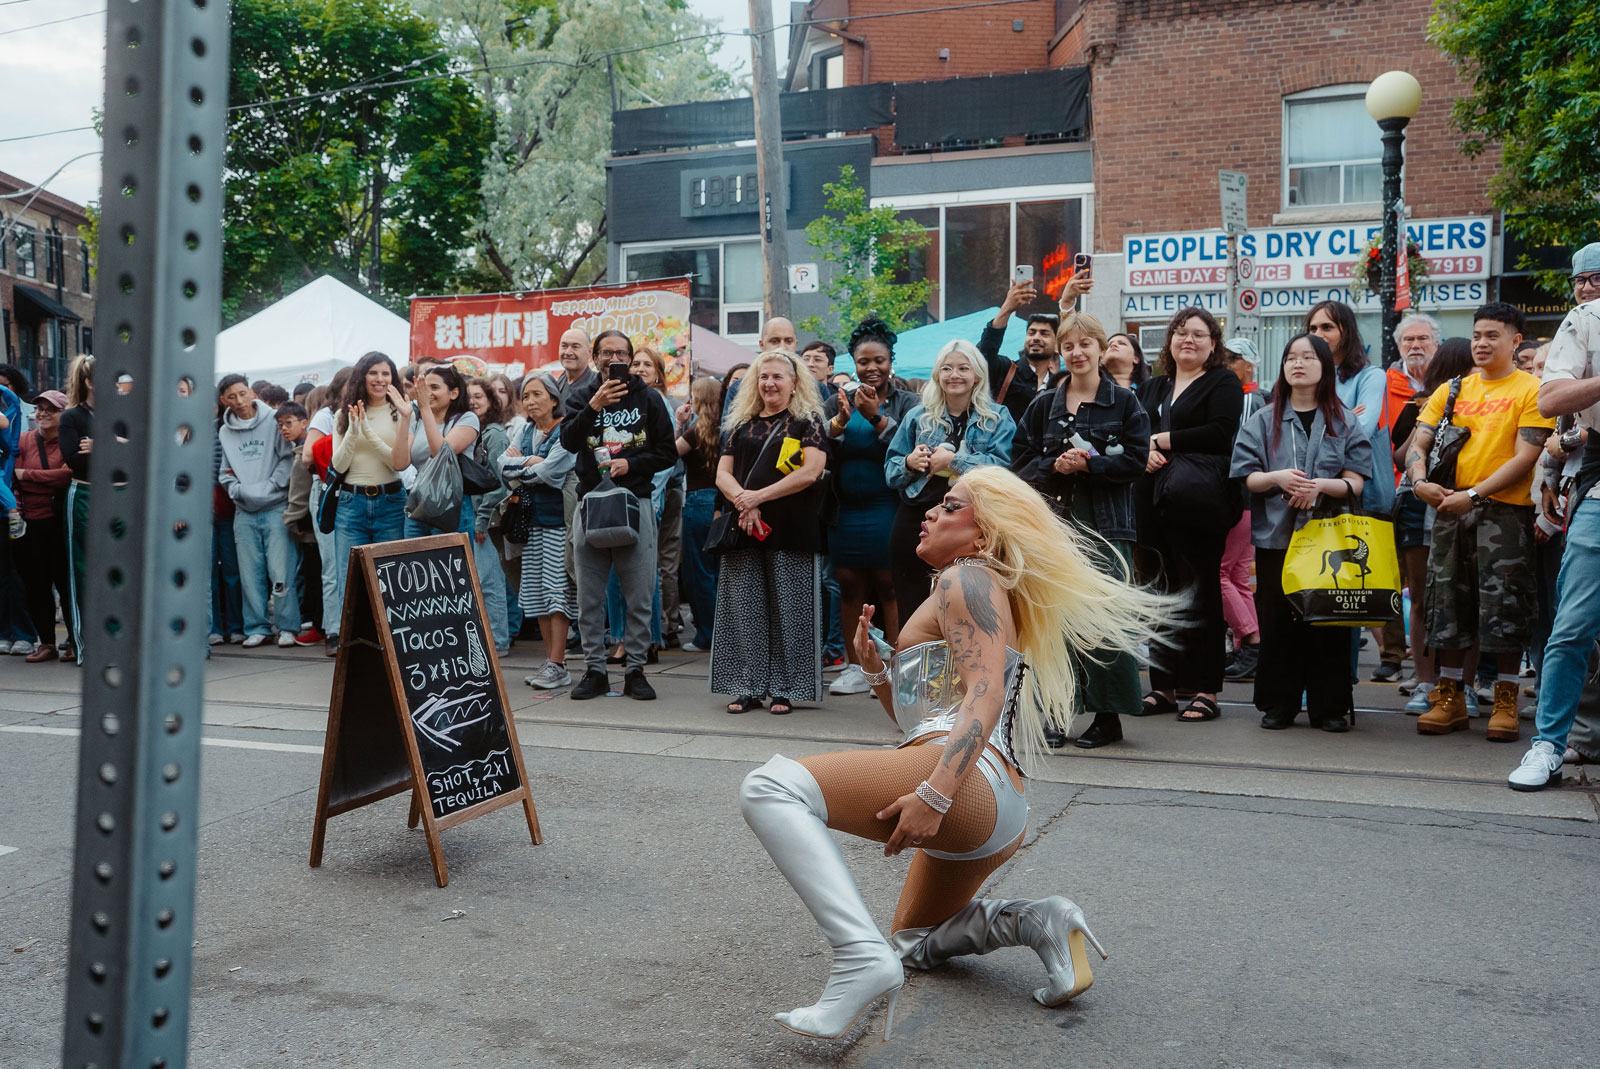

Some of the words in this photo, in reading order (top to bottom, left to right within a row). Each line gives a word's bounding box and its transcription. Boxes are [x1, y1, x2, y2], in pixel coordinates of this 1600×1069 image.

[1128, 234, 1257, 264] PEOPLES
[1266, 230, 1322, 259] DRY
[1132, 270, 1178, 285] SAME
[1181, 268, 1212, 283] DAY
[550, 297, 605, 316] TEPPAN
[606, 294, 658, 311] MINCED
[1261, 289, 1320, 307] DONE
[434, 310, 549, 349] 铁板虾滑
[1335, 595, 1367, 603] OLIVE
[1342, 602, 1360, 610] OIL
[392, 626, 458, 653] Tacos
[432, 780, 502, 814] TEQUILA
